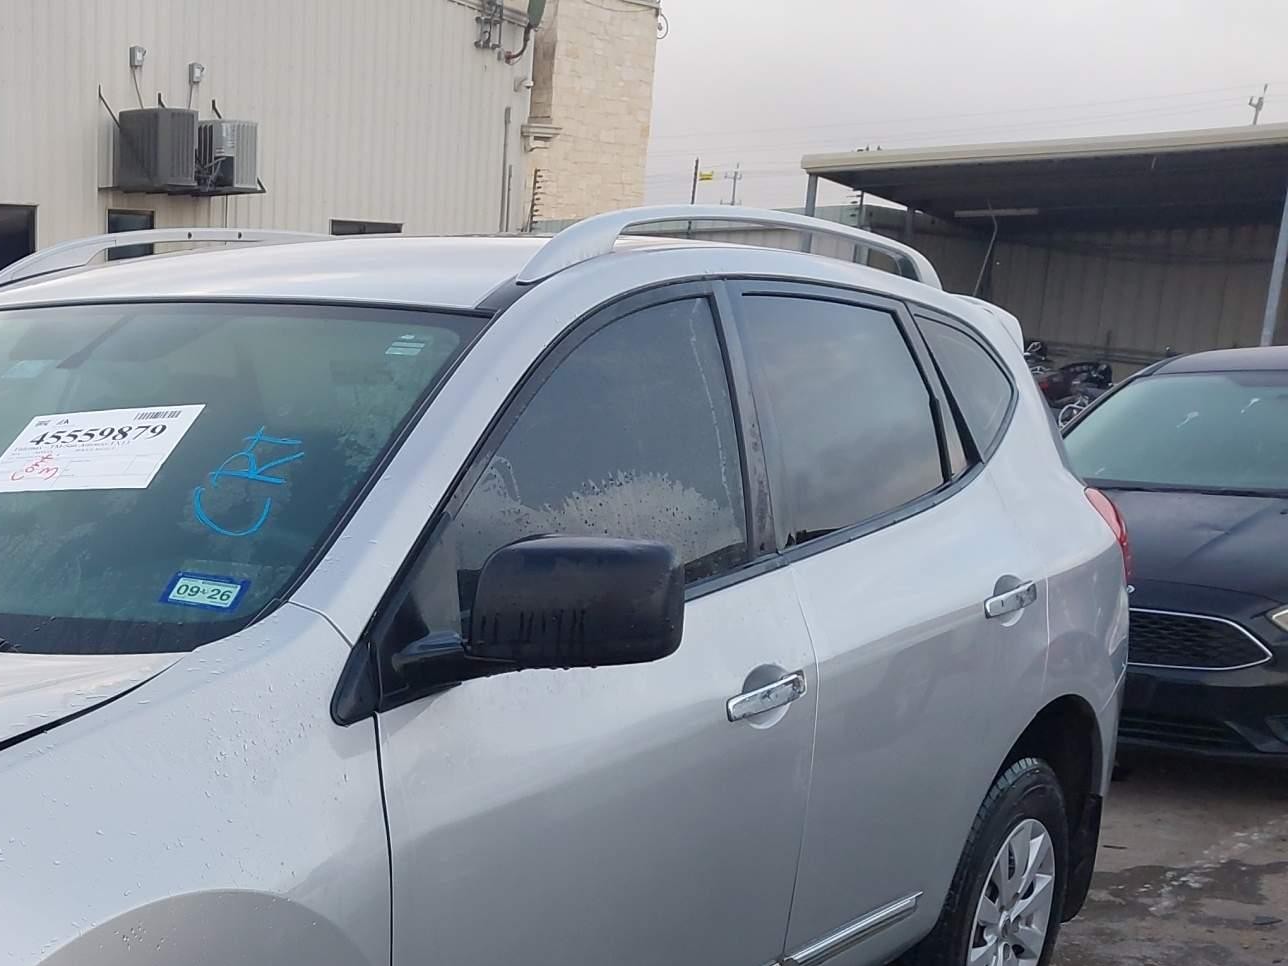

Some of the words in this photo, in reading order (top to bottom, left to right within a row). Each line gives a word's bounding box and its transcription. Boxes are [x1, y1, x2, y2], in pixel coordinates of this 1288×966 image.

[30, 423, 167, 447] 45559879
[192, 425, 305, 537] CRT
[176, 583, 201, 598] 09
[206, 587, 234, 602] 26
